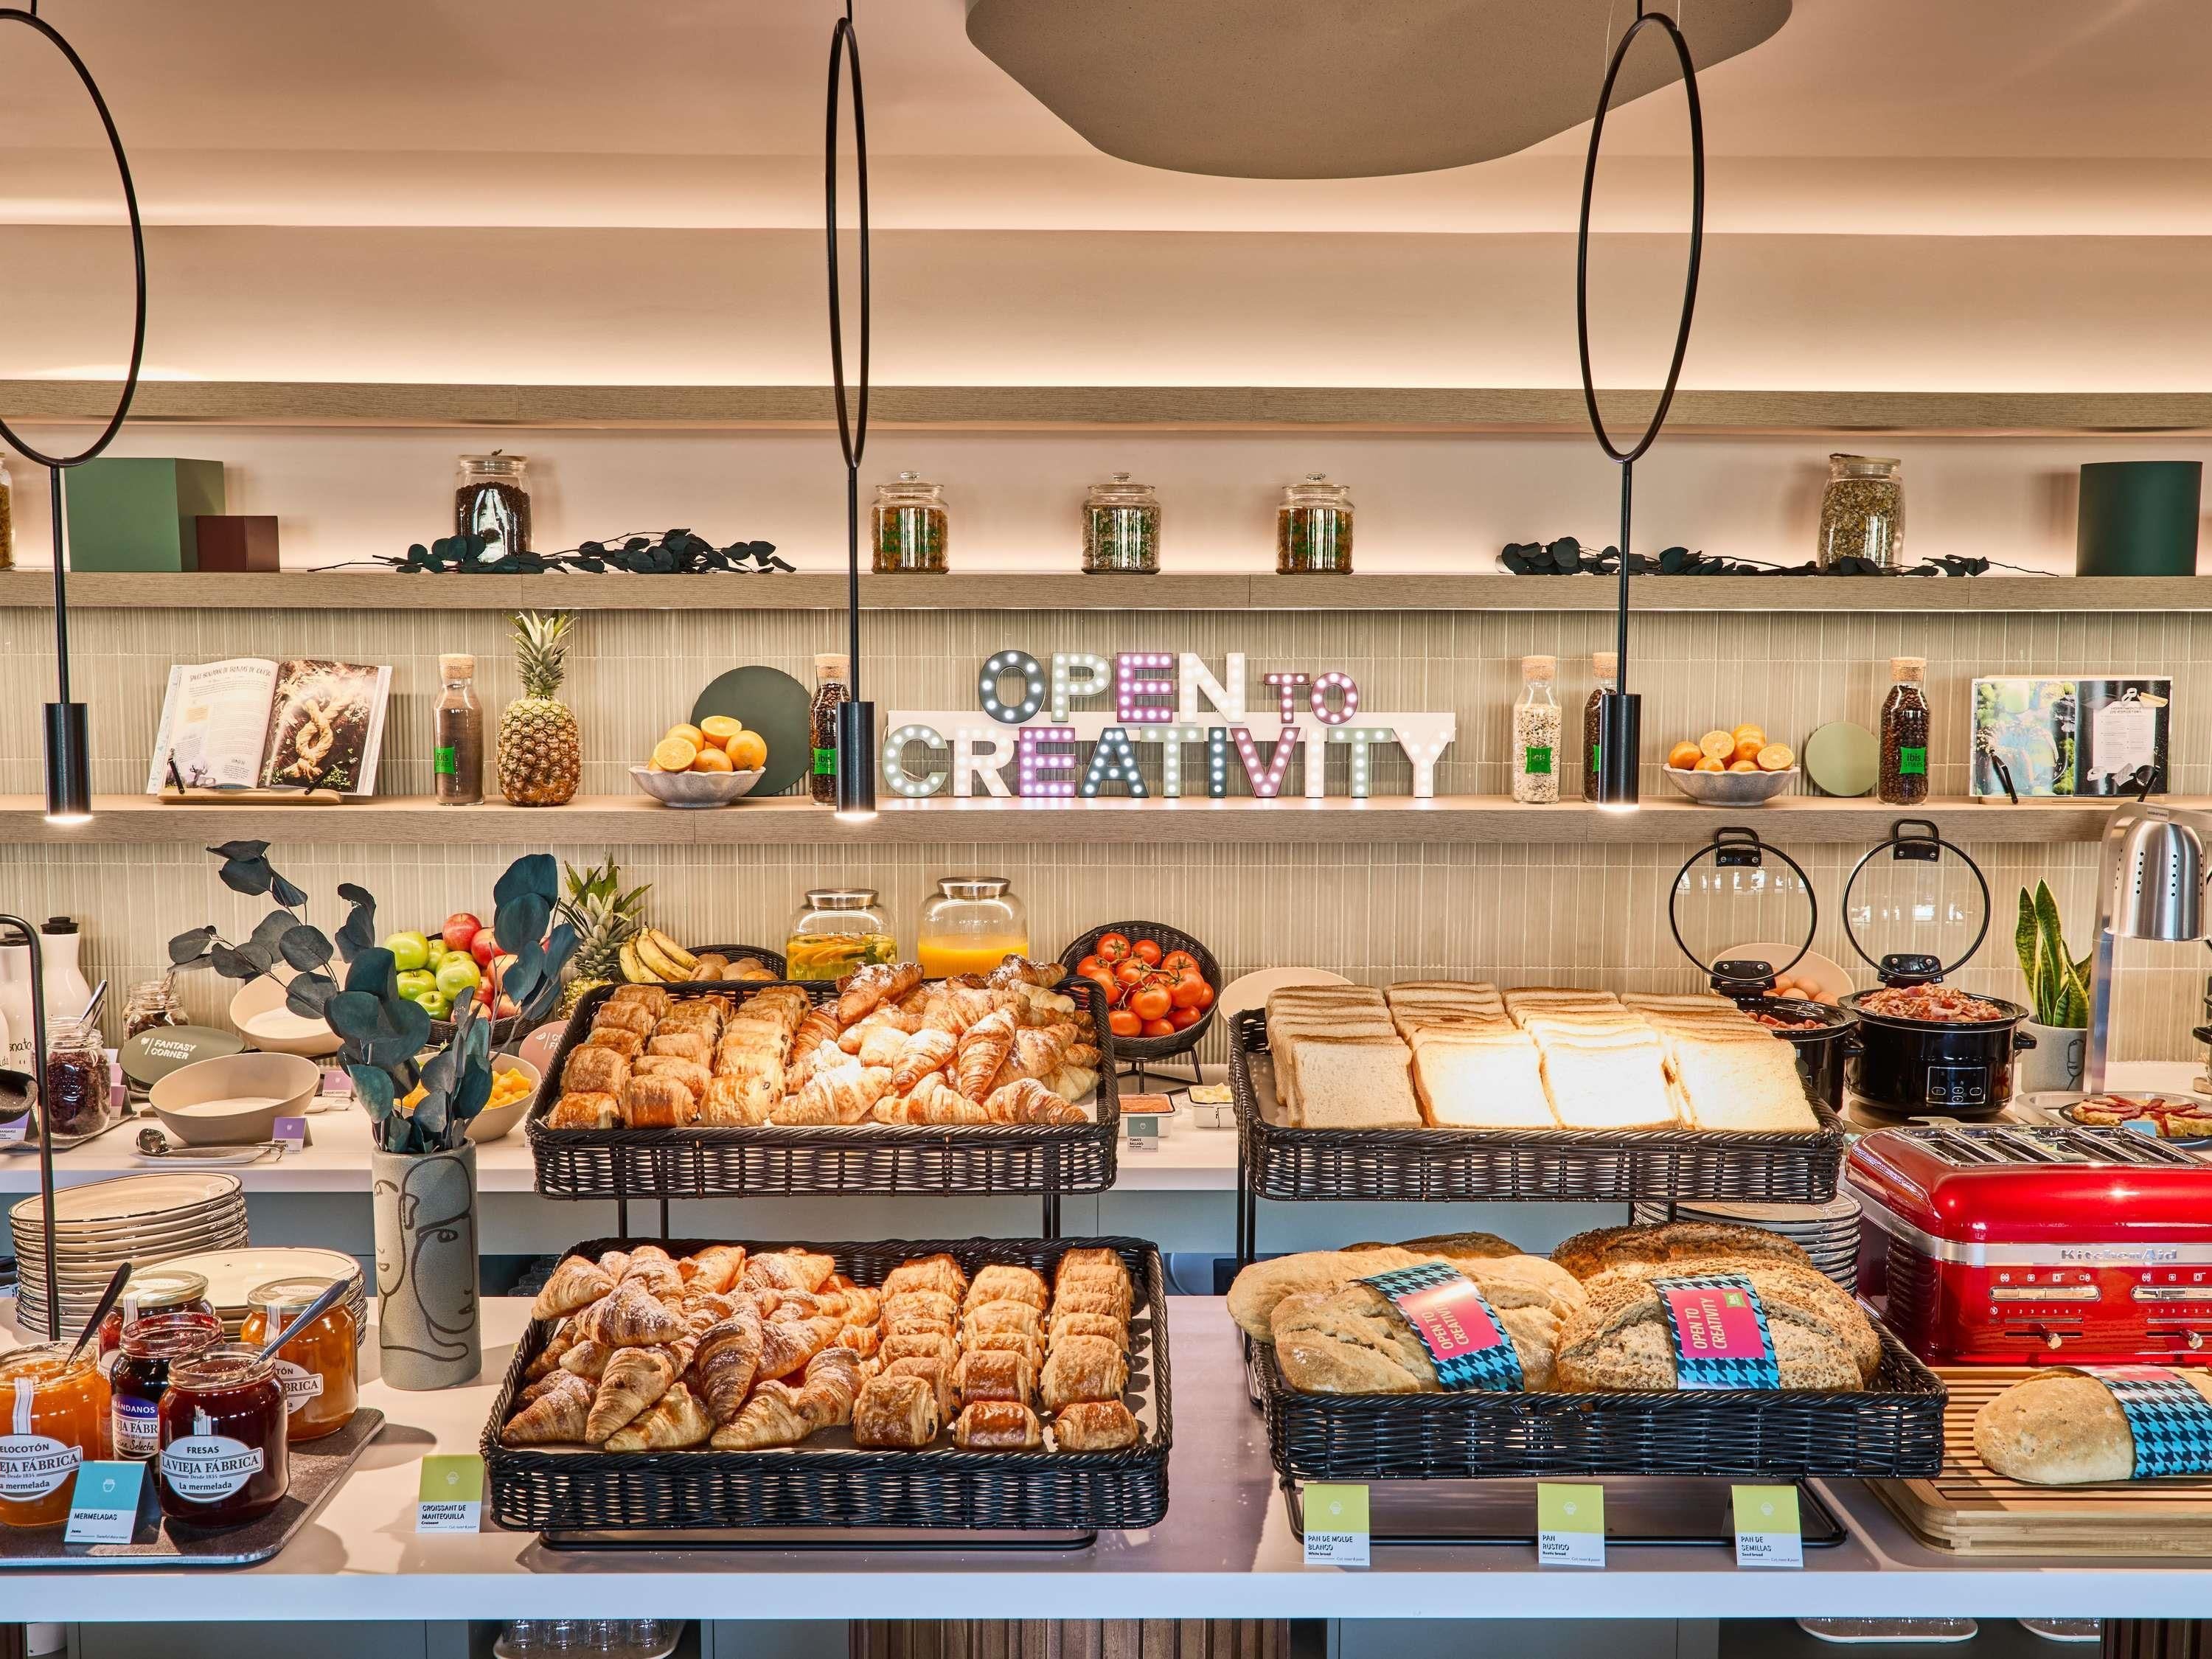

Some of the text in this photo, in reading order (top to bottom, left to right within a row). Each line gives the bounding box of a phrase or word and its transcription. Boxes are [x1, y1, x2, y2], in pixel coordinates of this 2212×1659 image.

[978, 650, 1359, 725] OPEN TO
[882, 723, 1456, 798] CREATIVITY
[1907, 753, 1921, 762] ibis
[154, 1039, 197, 1052] FANTASY
[150, 1048, 189, 1060] CORNER
[2061, 1249, 2177, 1261] KitchenAid
[1684, 1307, 1708, 1349] OPEN TO
[1699, 1297, 1728, 1349] CREATIVITY
[1422, 1312, 1454, 1349] OPEN TO
[129, 1439, 156, 1451] Selecta
[187, 1445, 220, 1454] FRESAS
[22, 1453, 79, 1472] FÁBRICA
[161, 1455, 259, 1475] LA VIEJA FÁBRICA
[6, 1480, 50, 1489] mermelada
[179, 1481, 232, 1490] La mermelada
[74, 1512, 118, 1521] MERMELADAS
